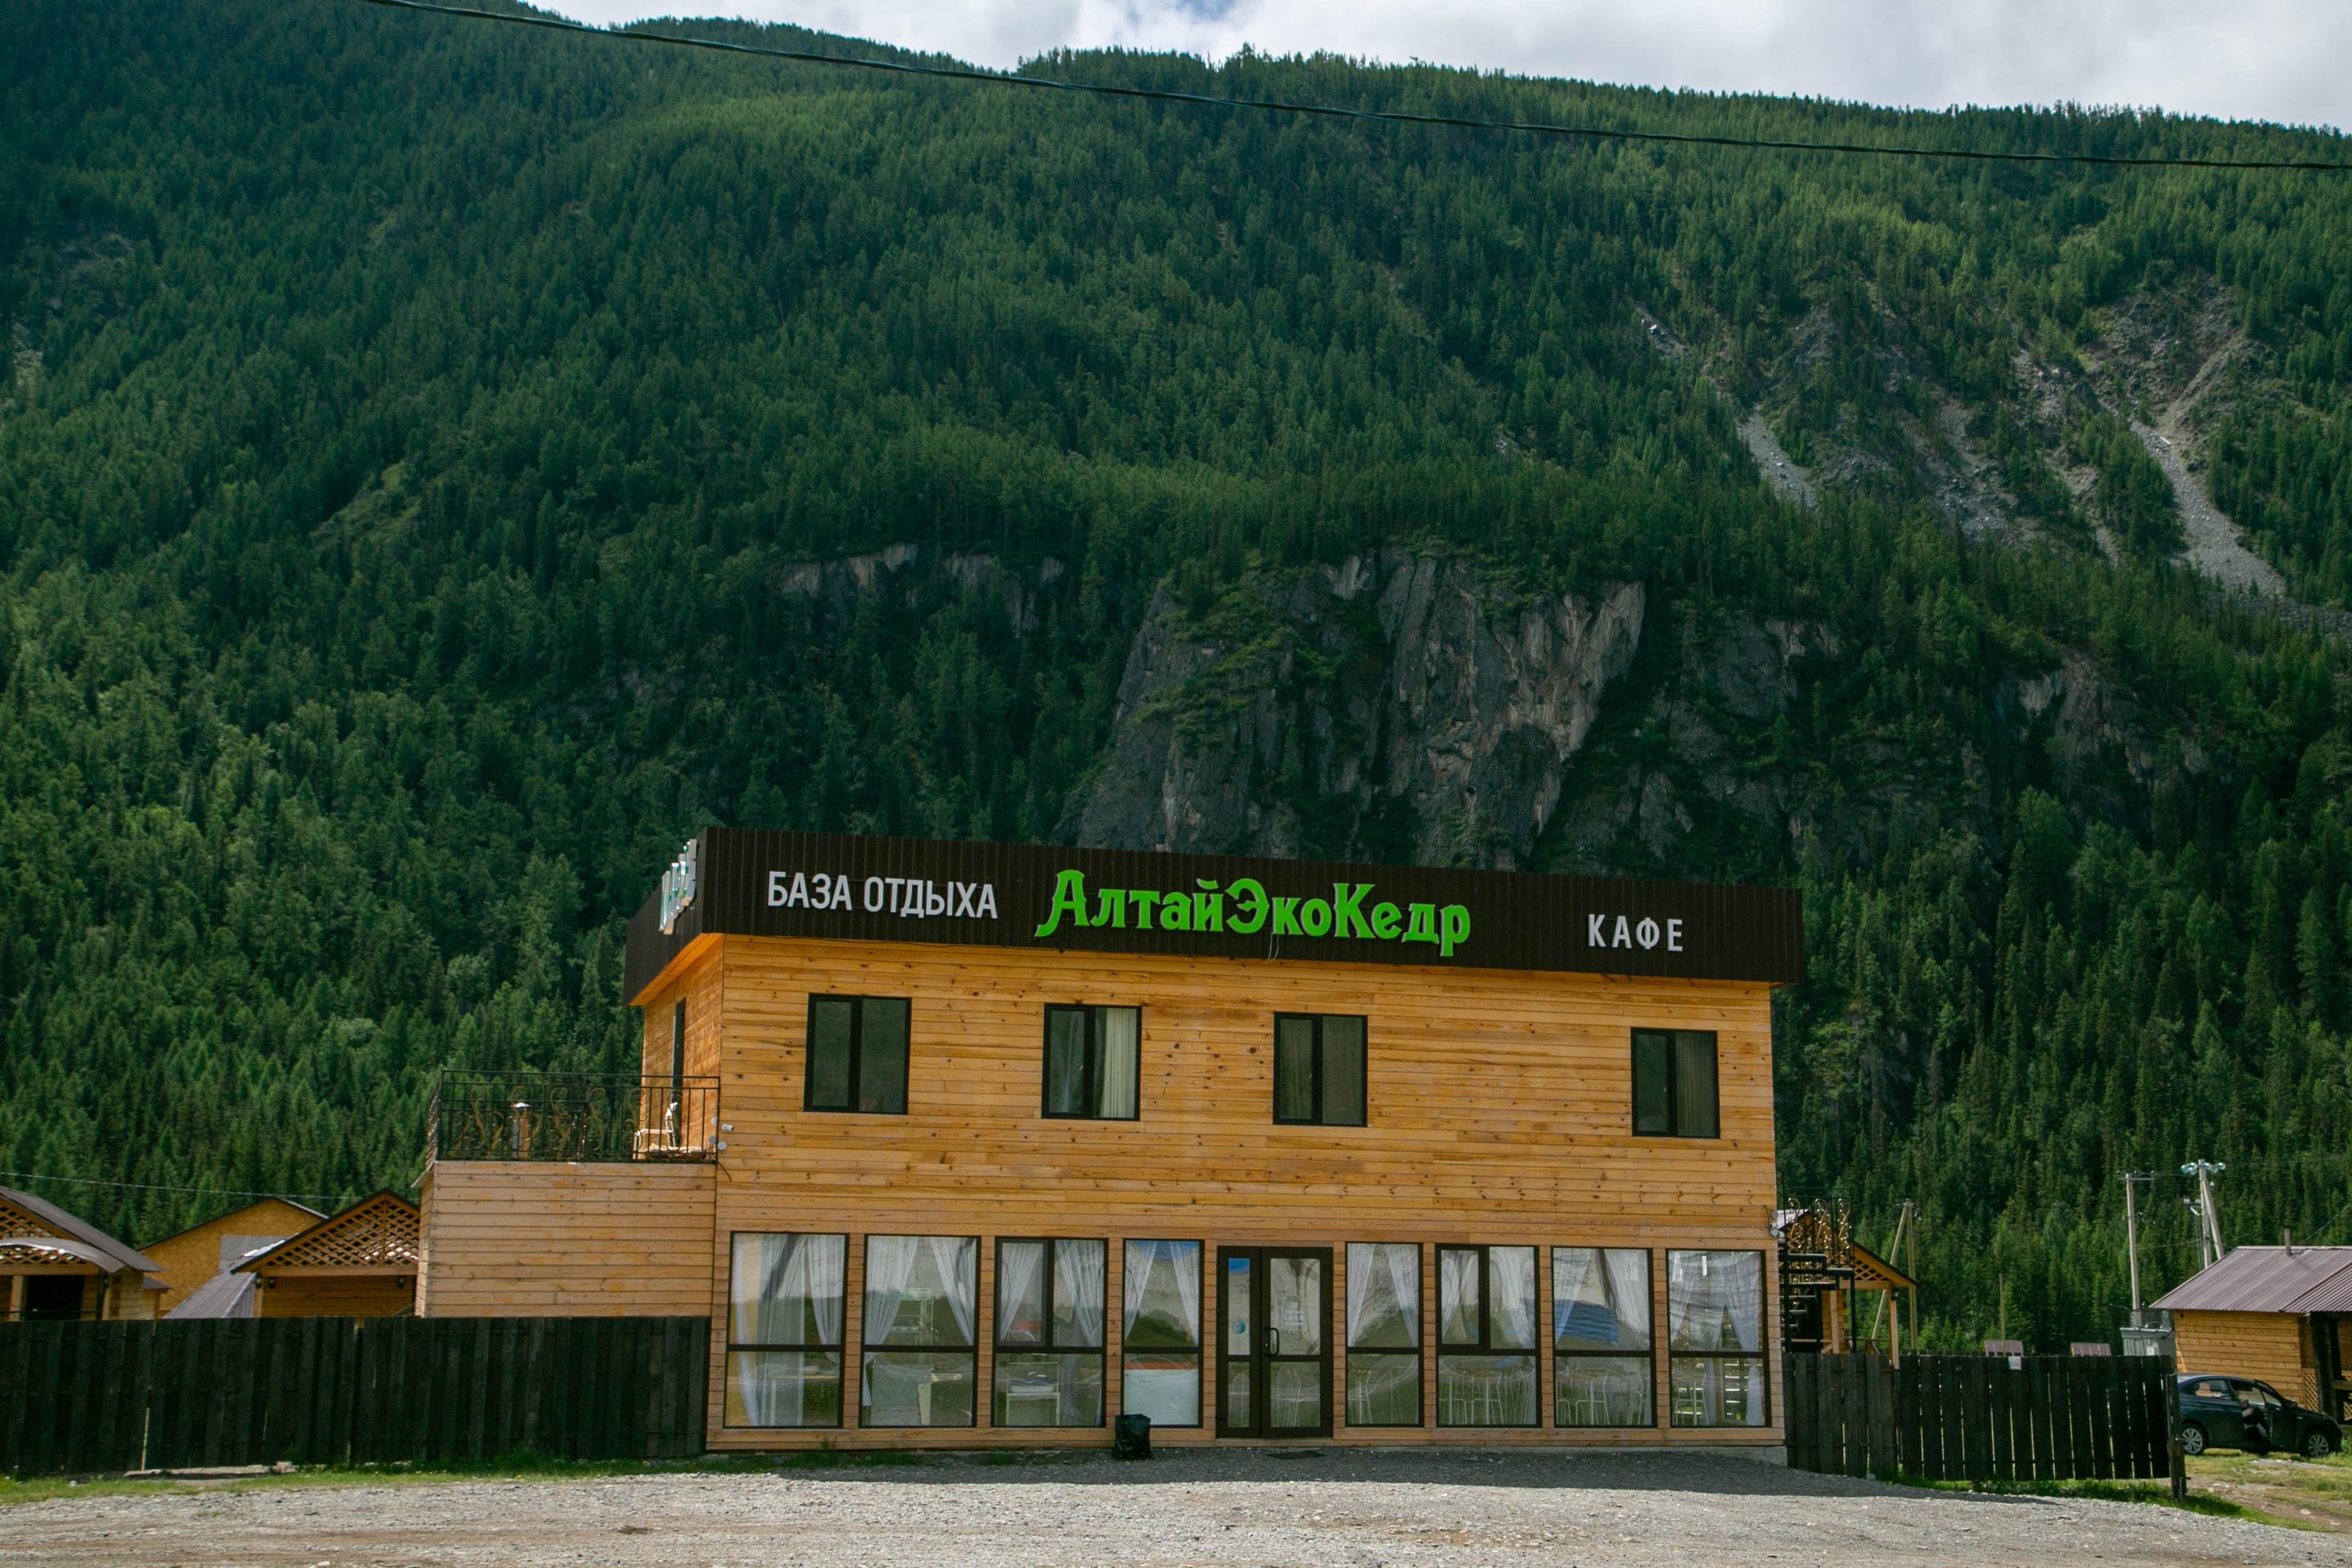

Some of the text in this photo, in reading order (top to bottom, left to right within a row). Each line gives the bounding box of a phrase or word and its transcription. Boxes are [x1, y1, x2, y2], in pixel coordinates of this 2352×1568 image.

[767, 871, 998, 919] БАЗА ОТДЫХА
[1034, 869, 1471, 956] АлтайЭкоКедр
[1588, 914, 1683, 952] КАФЕ
